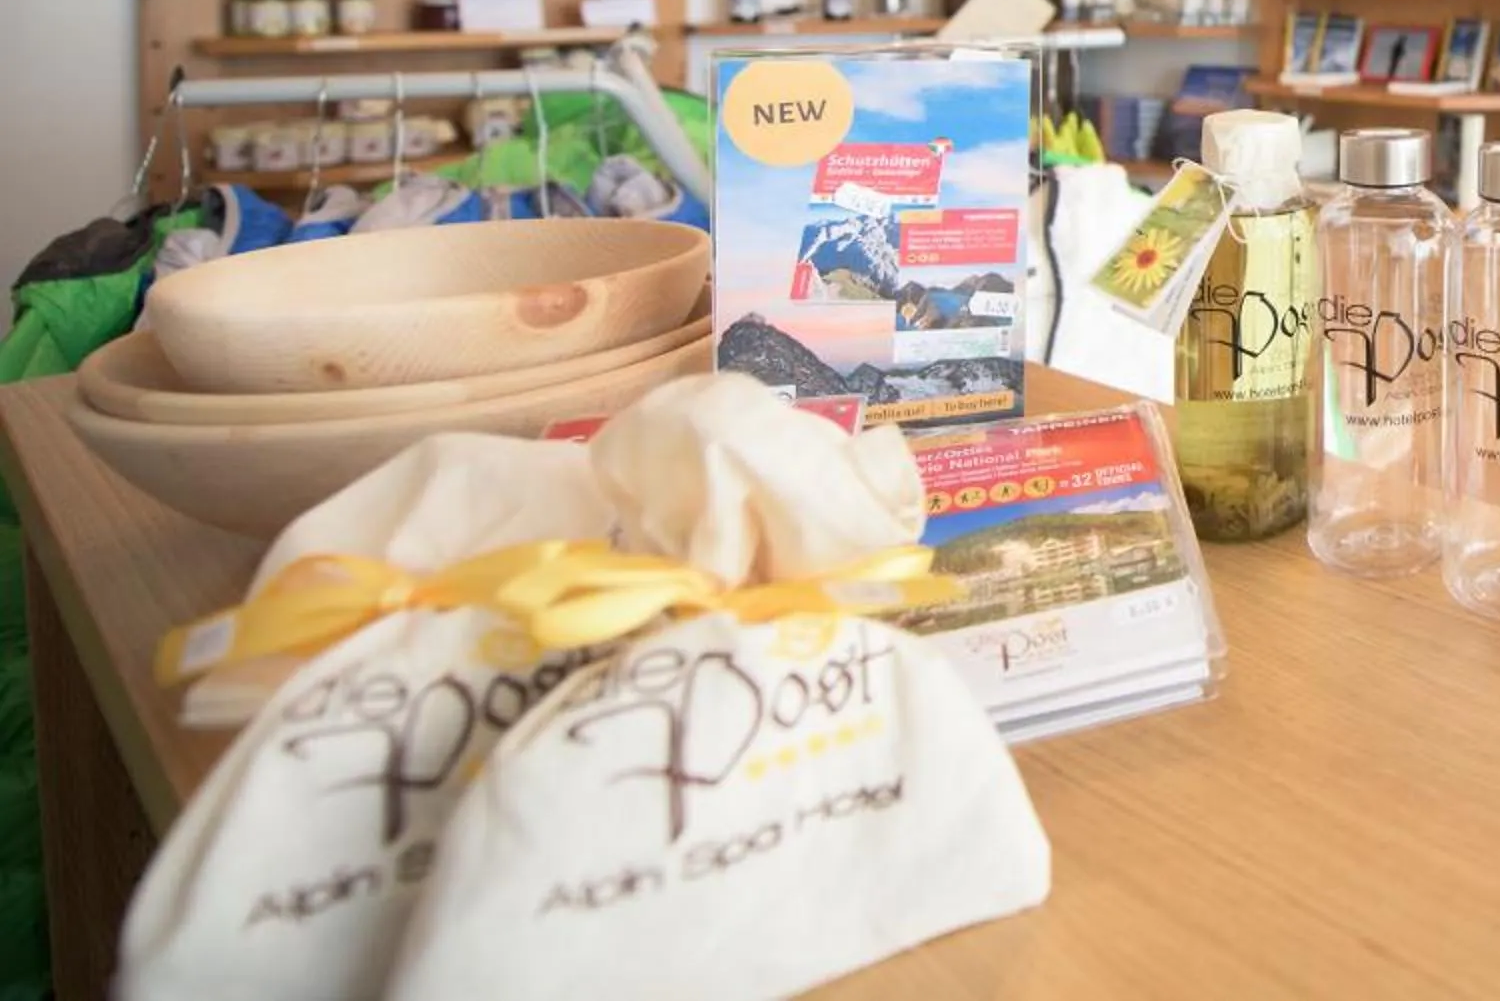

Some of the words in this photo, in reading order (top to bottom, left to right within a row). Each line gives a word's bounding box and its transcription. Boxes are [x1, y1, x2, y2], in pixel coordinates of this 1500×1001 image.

[752, 99, 827, 126] NEW
[1318, 294, 1373, 327] die
[949, 452, 1020, 470] National
[1071, 472, 1092, 488] 32
[563, 623, 897, 845] Post
[534, 868, 664, 918] Alpin
[680, 822, 783, 882] Spa
[793, 774, 905, 833] Hotel
